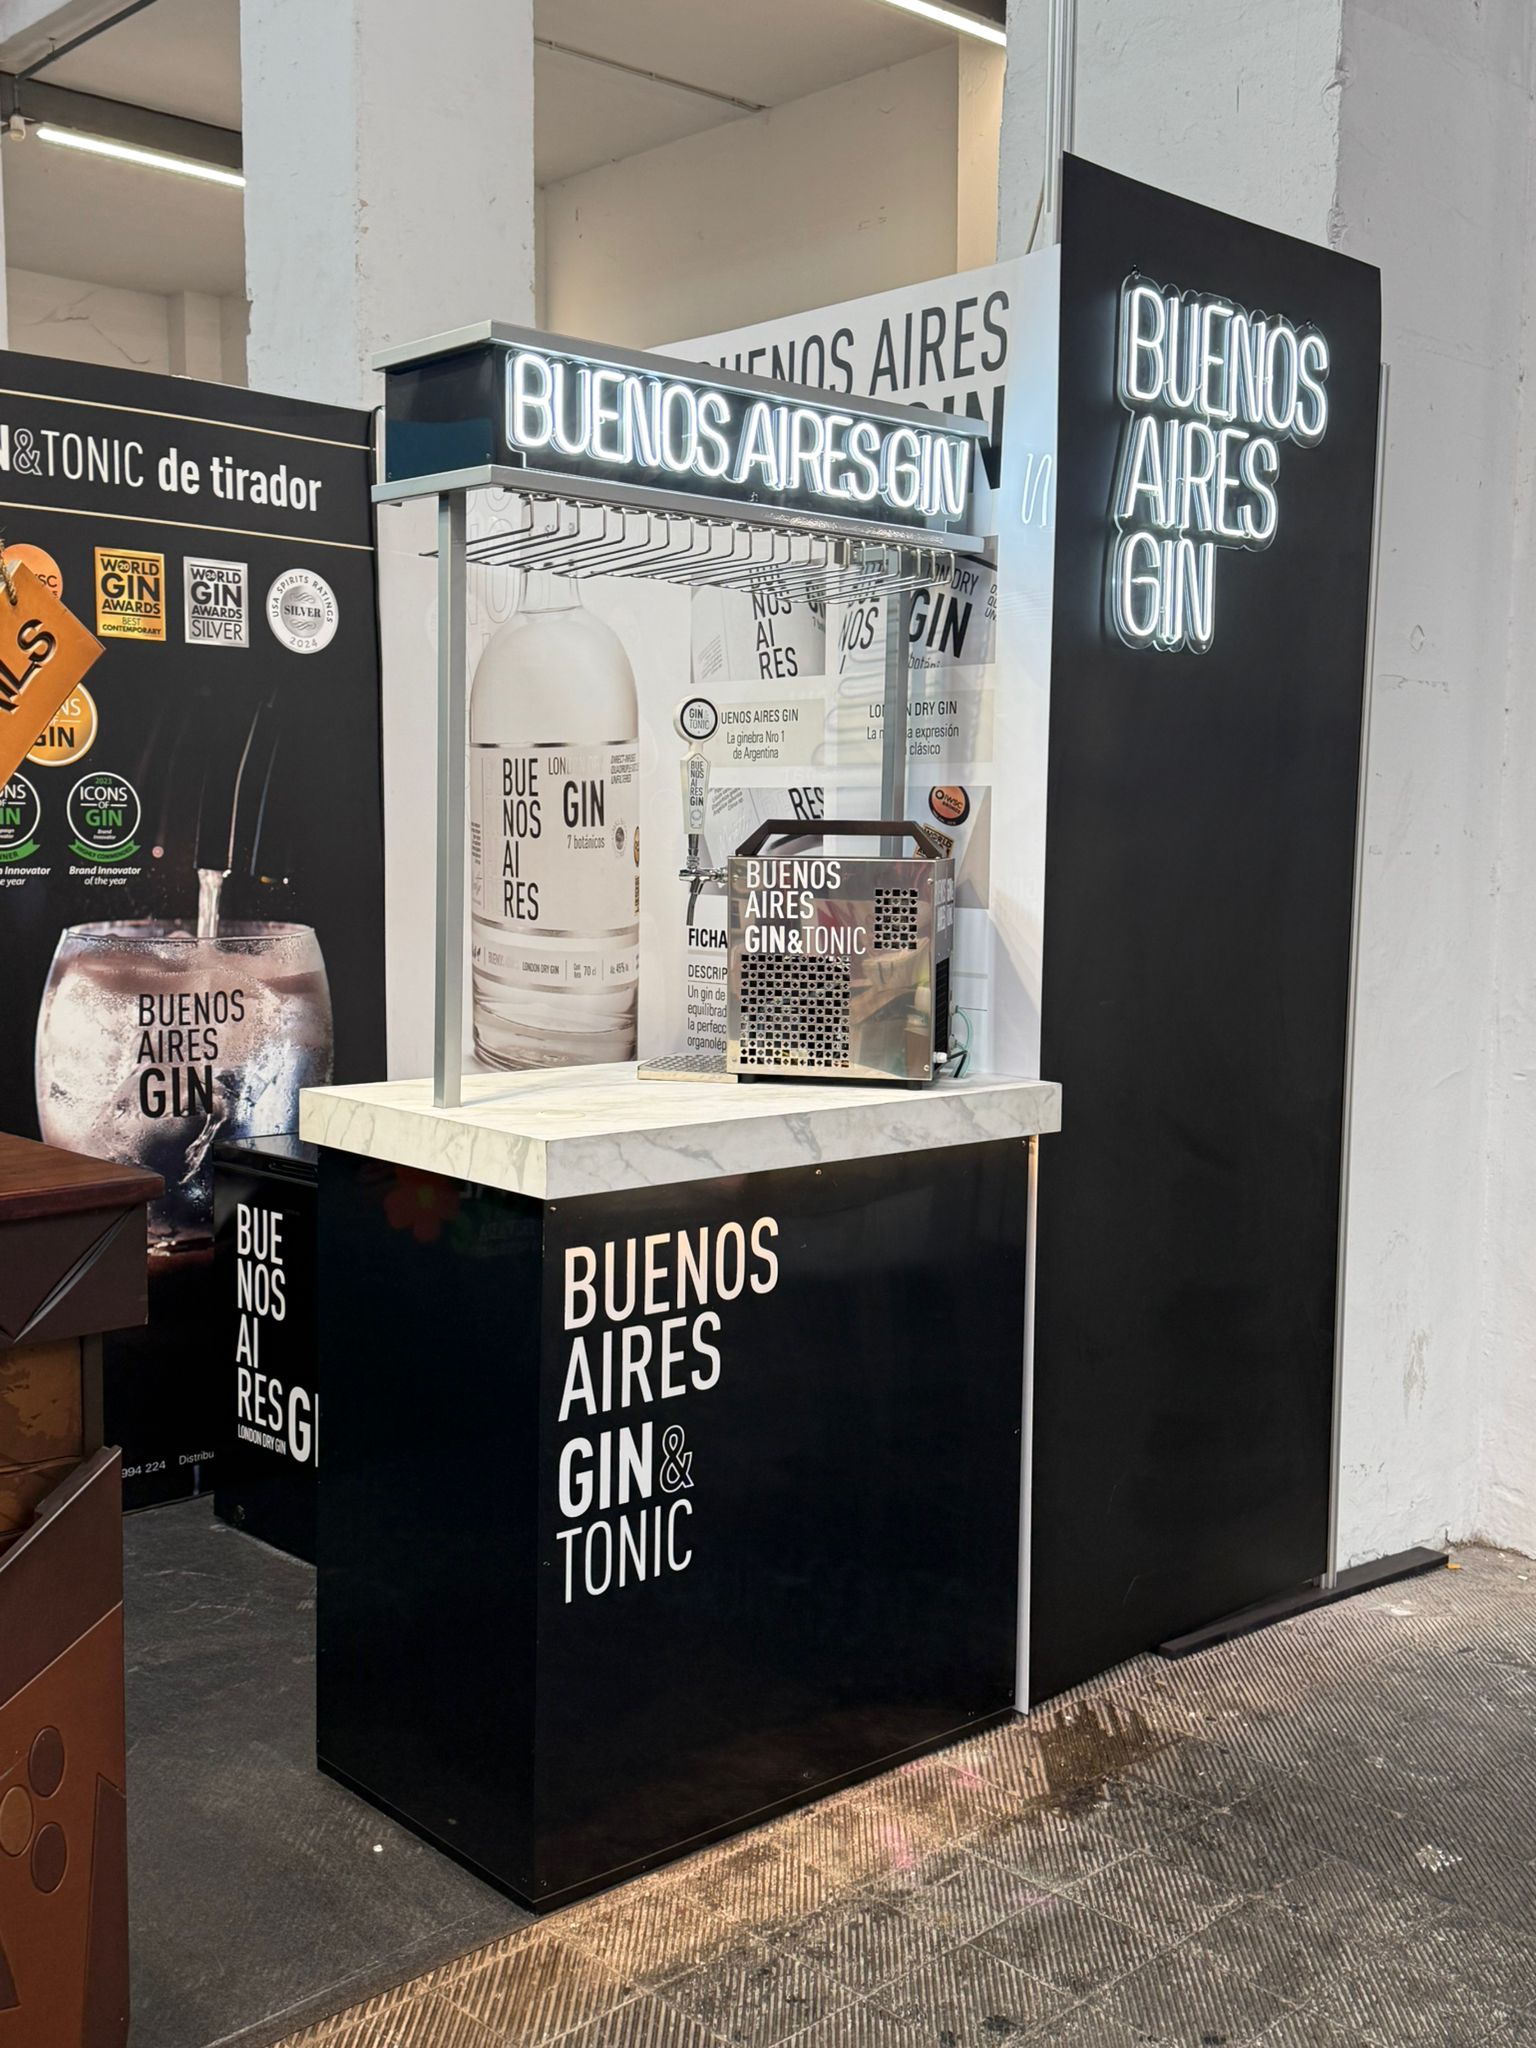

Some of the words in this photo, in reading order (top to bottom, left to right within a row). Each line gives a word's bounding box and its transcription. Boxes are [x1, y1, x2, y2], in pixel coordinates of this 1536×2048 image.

[698, 327, 855, 395] NOS
[868, 290, 1010, 396] AIRES
[1126, 287, 1328, 437] BUENOS
[509, 352, 730, 477] BUENOS
[730, 400, 880, 501] AIRES
[881, 427, 970, 516] GIN
[158, 447, 200, 495] de
[210, 456, 322, 512] tirador
[1121, 415, 1278, 540] AIRES
[100, 558, 160, 577] WORLD
[190, 568, 242, 585] WORLD
[101, 572, 161, 603] GIN
[190, 581, 243, 608] GIN
[951, 568, 980, 596] DRY
[1117, 531, 1215, 643] GIN
[102, 599, 161, 615] AWARDS
[191, 606, 243, 620] AWARDS
[272, 597, 280, 617] USA
[277, 575, 309, 595] SPIRITS
[312, 580, 334, 624] RATINGS
[283, 604, 322, 619] SILVER
[102, 624, 162, 636] CONTEMPORARY
[121, 616, 142, 626] BEST
[191, 619, 243, 642] SILVER
[757, 618, 775, 651] AI
[909, 588, 973, 659] GIN
[289, 636, 319, 649] 2024
[759, 647, 798, 680] RES
[689, 708, 704, 719] GIN
[721, 711, 752, 724] UENOS
[753, 709, 780, 723] AIRES
[782, 708, 799, 722] GIN
[914, 702, 935, 716] DRY
[938, 700, 957, 715] GIN
[726, 731, 736, 744] La
[736, 731, 764, 747] ginebra
[765, 730, 779, 743] Nro
[781, 730, 785, 743] 1
[867, 726, 877, 739] La
[915, 725, 960, 742] expresión
[732, 747, 743, 760] de
[744, 747, 779, 761] Argentina
[909, 740, 941, 755] clásico
[503, 758, 539, 797] BUE
[80, 786, 128, 801] ICONS
[98, 801, 110, 809] OF
[563, 779, 605, 828] GIN
[690, 797, 704, 806] GIN
[85, 809, 123, 827] GIN
[503, 799, 541, 838] NOS
[567, 834, 573, 849] 7
[573, 834, 606, 849] botánicos
[5, 865, 51, 875] Innovator
[69, 865, 97, 875] Brand
[97, 865, 142, 876] Innovator
[503, 840, 519, 878] AI
[6, 878, 26, 888] year
[84, 877, 94, 886] of
[94, 877, 108, 886] the
[108, 878, 127, 888] year
[746, 860, 841, 889] BUENOS
[504, 880, 540, 921] RES
[744, 890, 814, 919] AIRES
[688, 928, 728, 949] FICHA
[687, 985, 699, 998] Un
[700, 986, 713, 1001] gin
[715, 988, 726, 1001] de
[138, 989, 245, 1027] BUENOS
[687, 1017, 695, 1030] la
[137, 1028, 218, 1064] AIRES
[139, 1065, 214, 1118] GIN
[237, 1203, 284, 1266] BUE
[564, 1216, 779, 1330] BUENOS
[237, 1258, 286, 1321] NOS
[236, 1313, 259, 1369] AI
[558, 1310, 721, 1422] AIRES
[237, 1367, 283, 1431] RES
[238, 1423, 262, 1446] LONDON
[262, 1433, 275, 1450] DRY
[275, 1437, 287, 1455] GIN
[145, 1460, 167, 1475] 224
[179, 1449, 215, 1466] Distribu
[556, 1498, 693, 1604] TONIC
